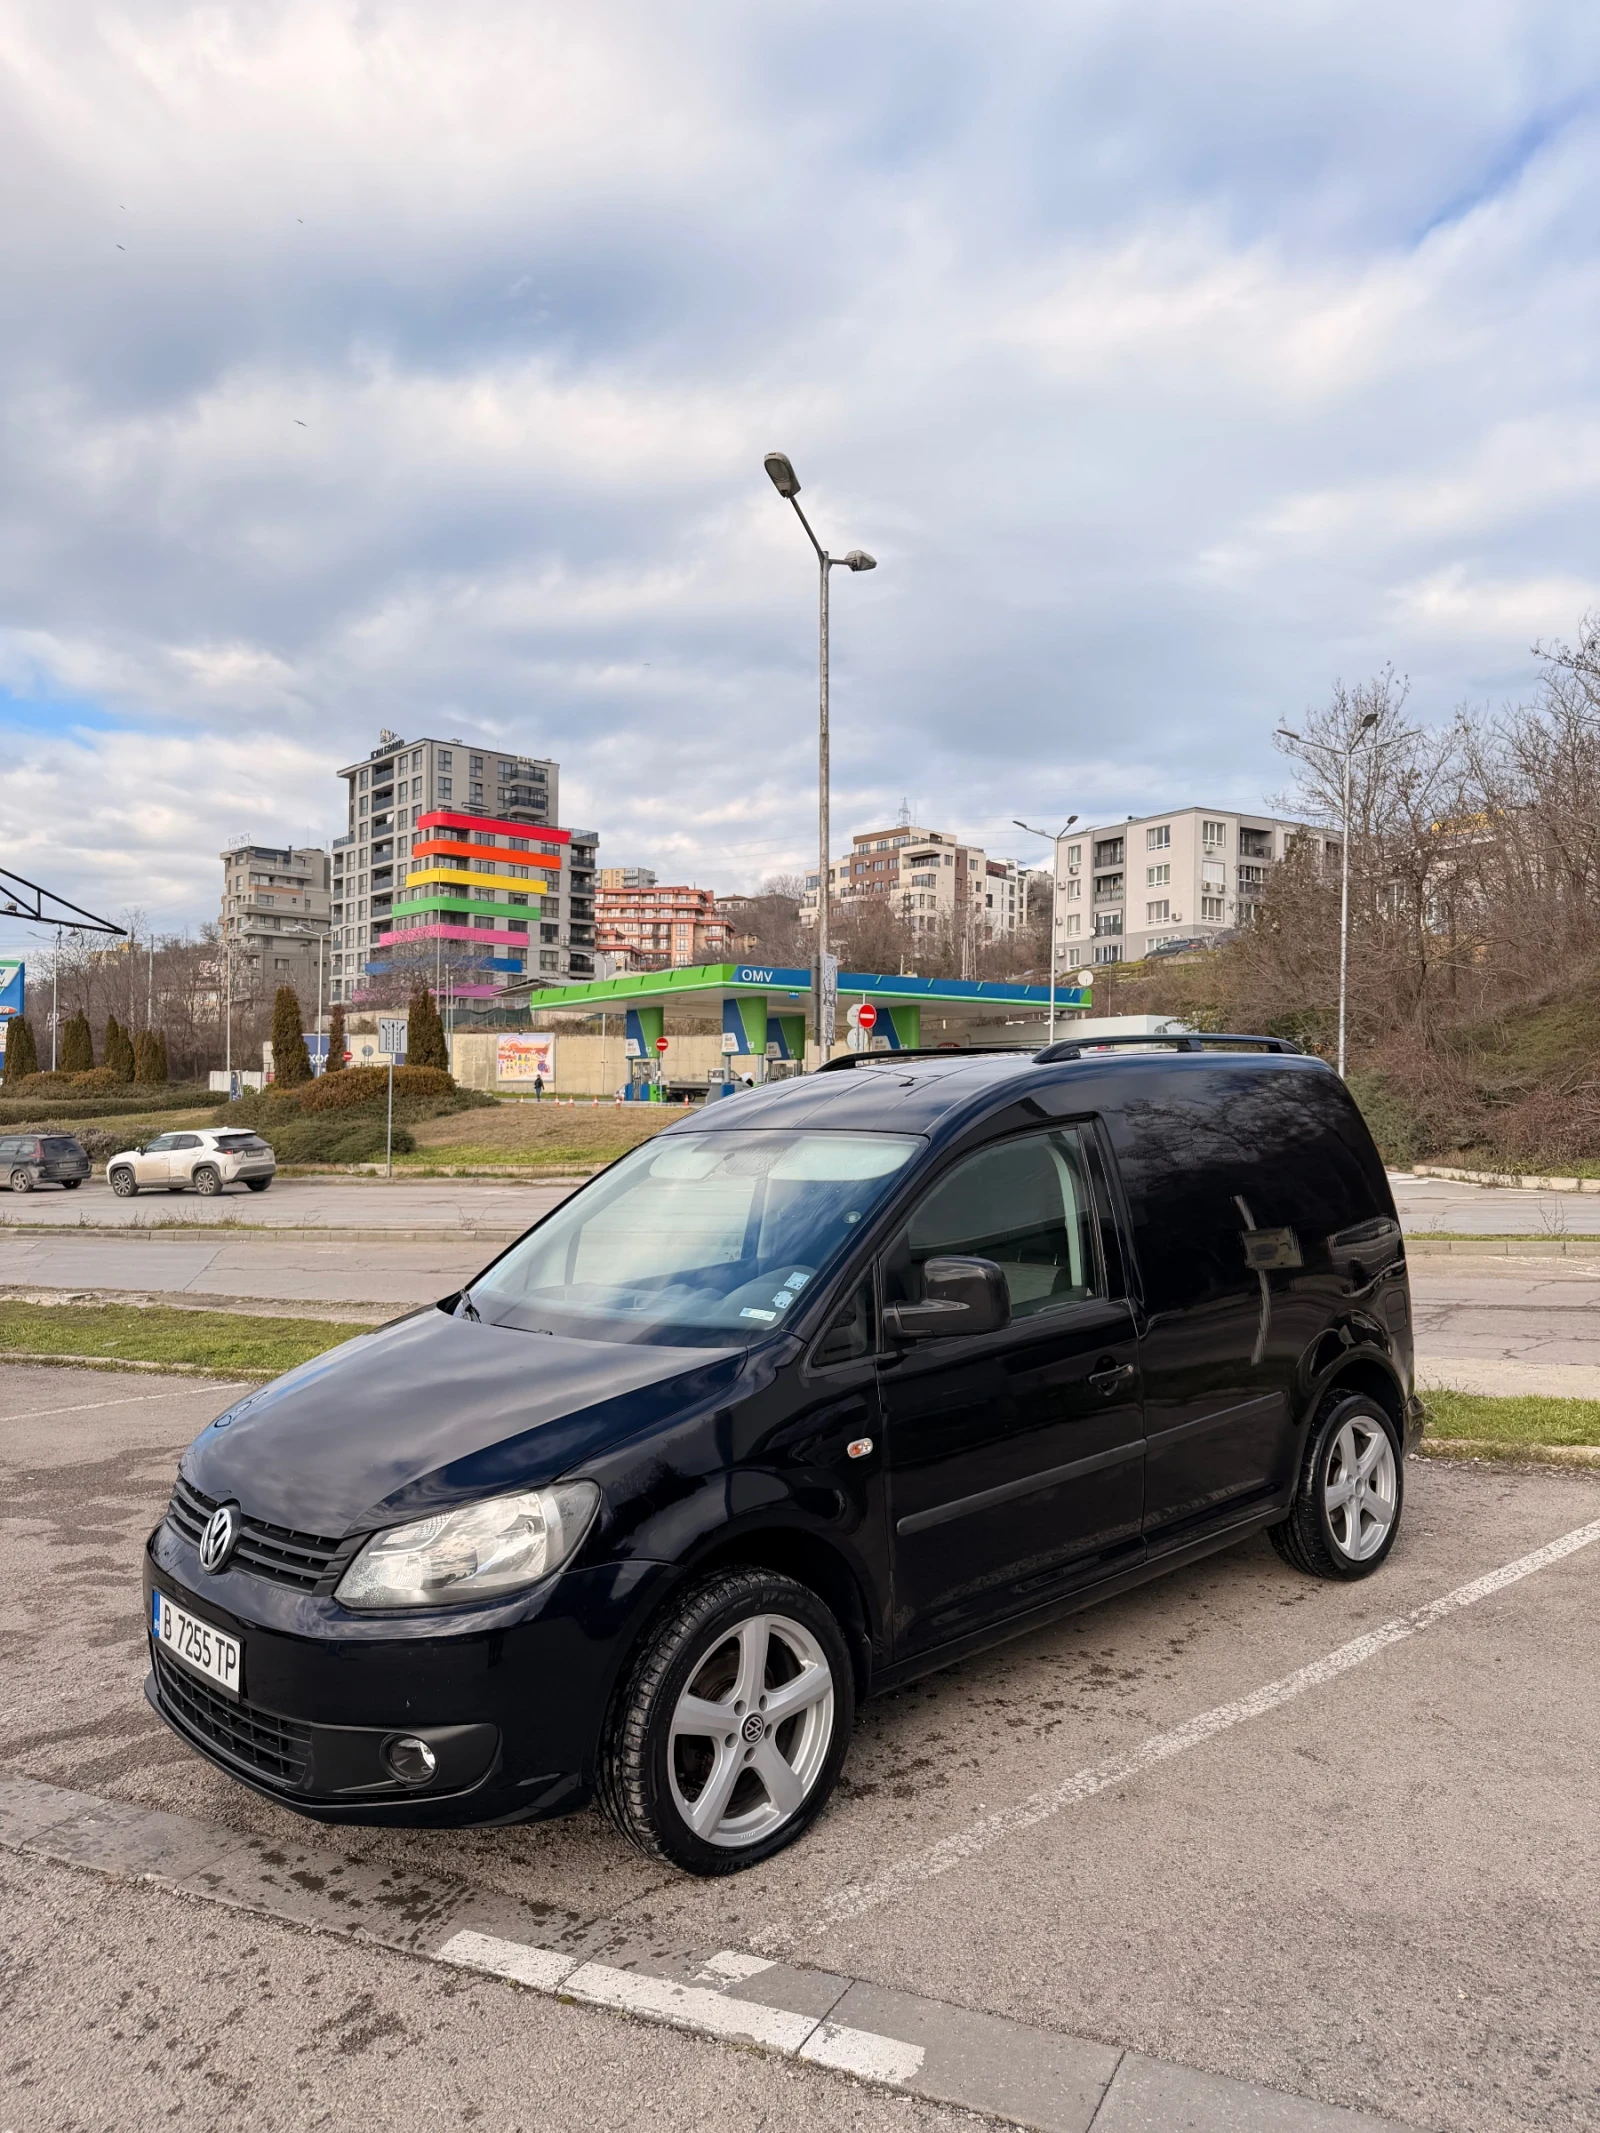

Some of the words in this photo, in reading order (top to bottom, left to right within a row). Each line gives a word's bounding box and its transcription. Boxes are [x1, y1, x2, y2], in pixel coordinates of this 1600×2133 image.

[741, 969, 773, 983] OMV
[164, 1604, 172, 1640] B
[177, 1614, 211, 1668] 7255
[215, 1637, 236, 1680] TP
